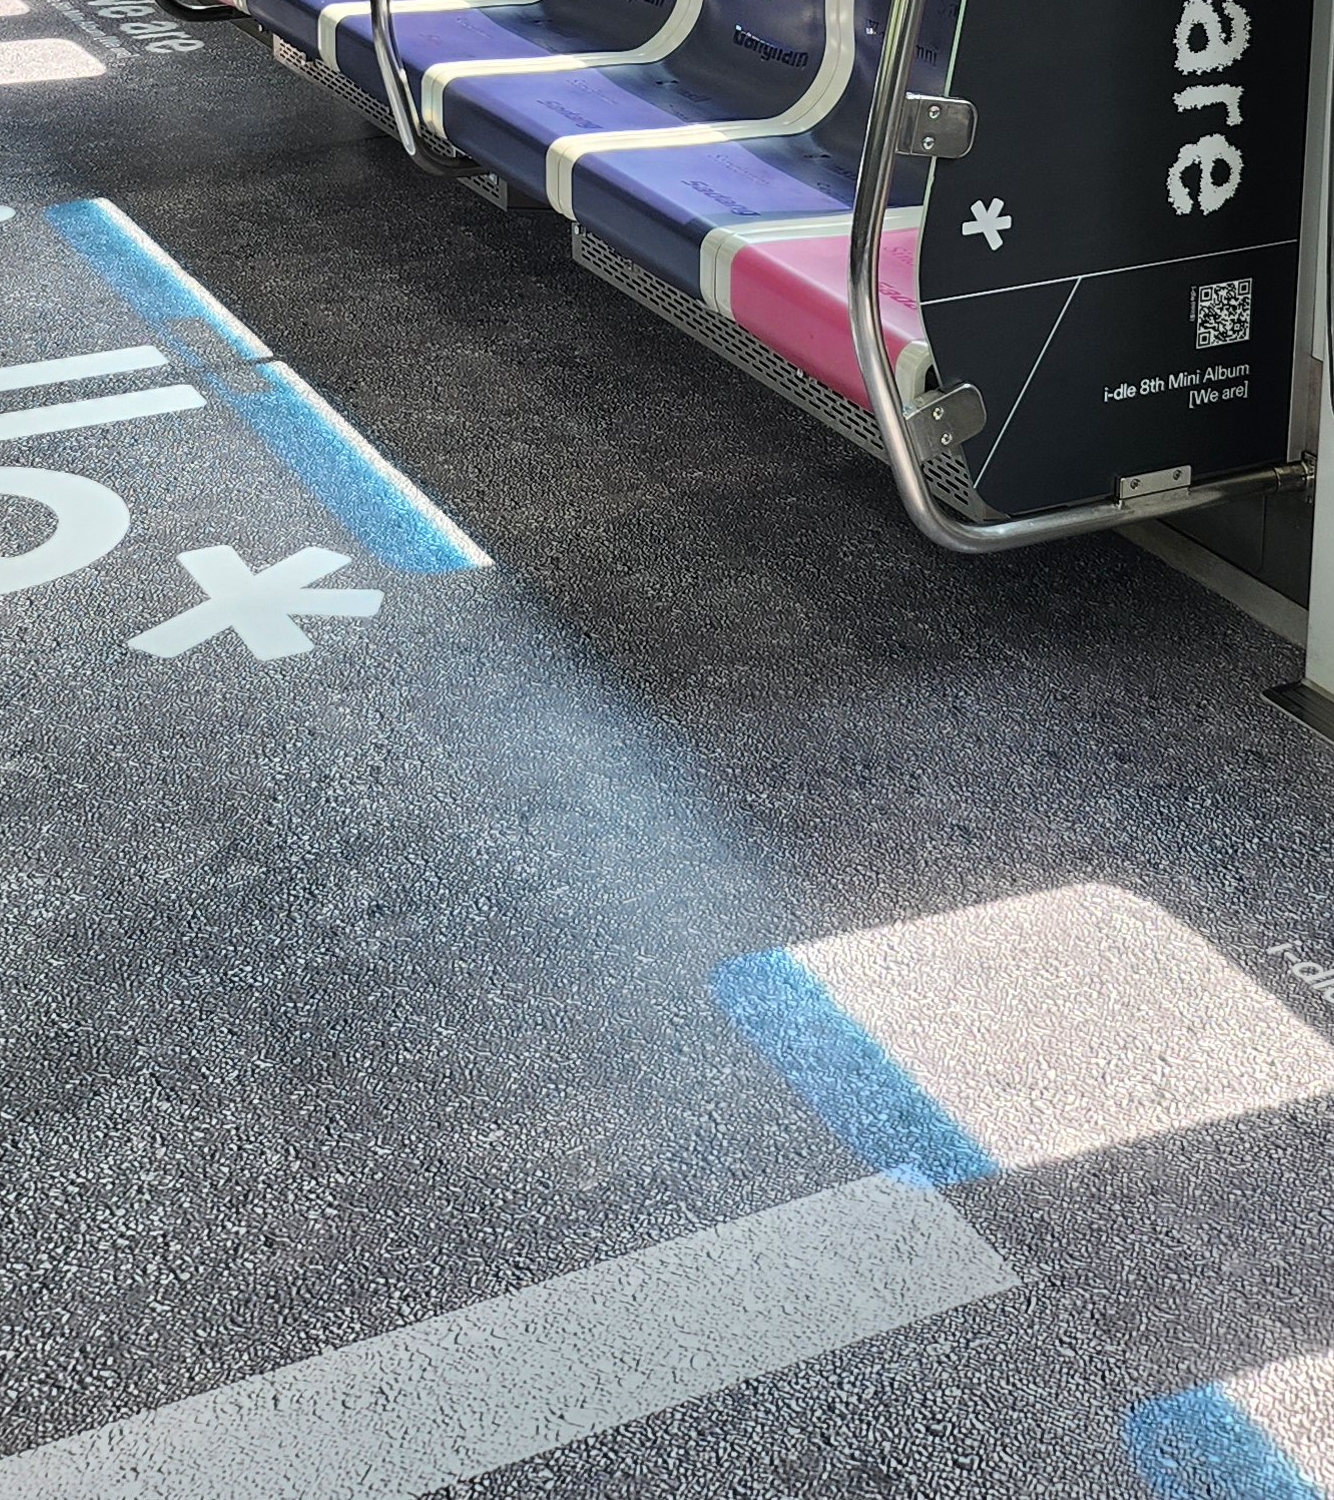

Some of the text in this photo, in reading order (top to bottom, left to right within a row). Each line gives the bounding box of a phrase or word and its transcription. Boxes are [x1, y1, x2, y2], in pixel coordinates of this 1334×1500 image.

[120, 20, 206, 54] are
[1103, 363, 1250, 403] i-dle 8th Mini Album
[1188, 380, 1249, 409] [We are]
